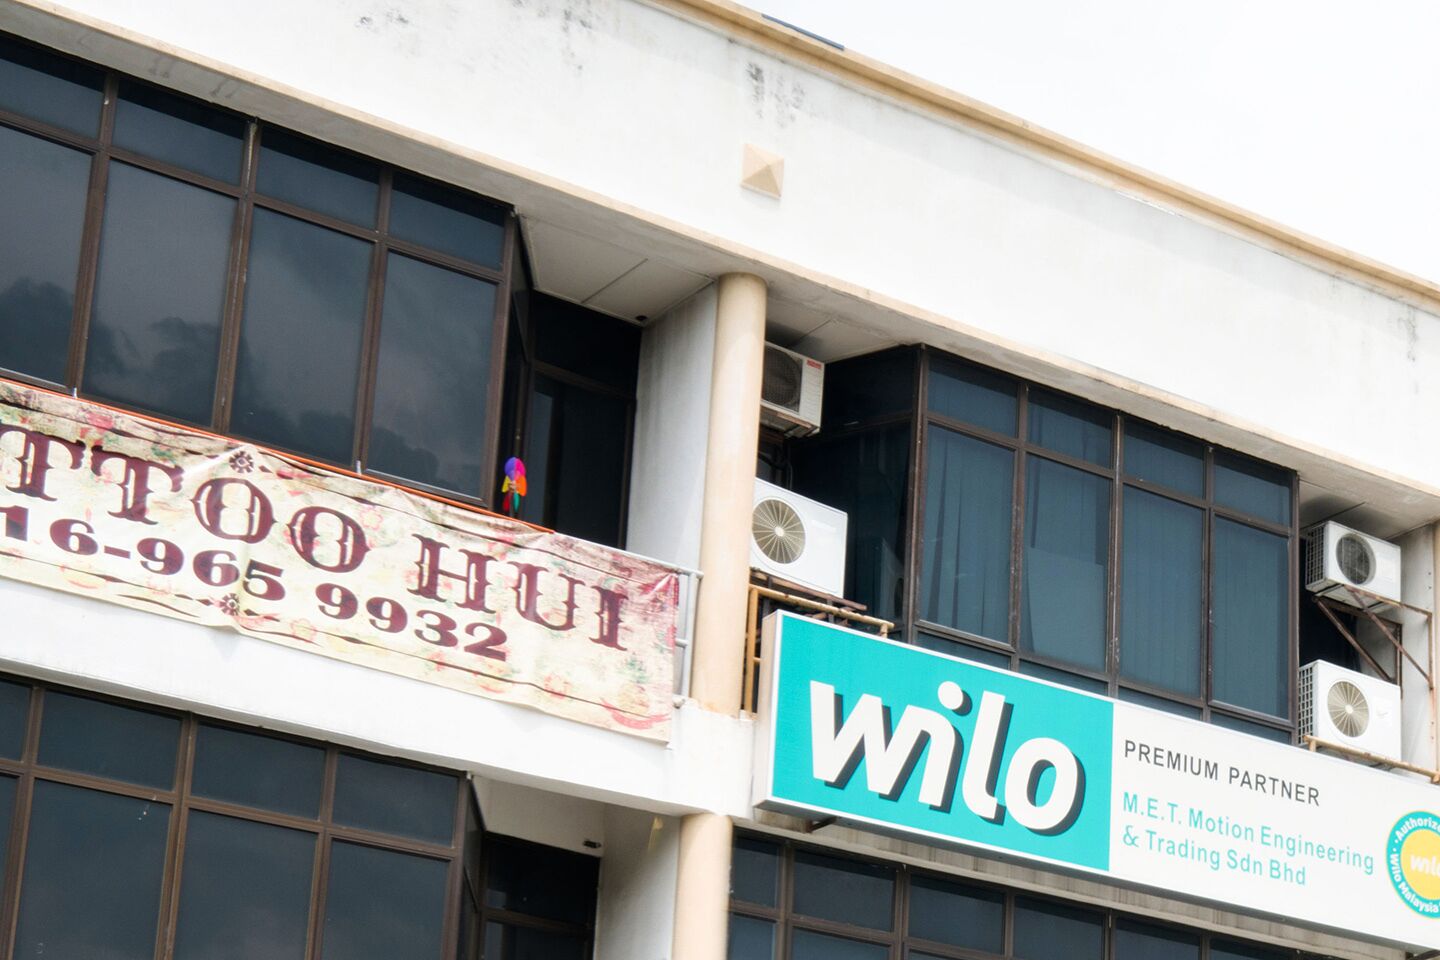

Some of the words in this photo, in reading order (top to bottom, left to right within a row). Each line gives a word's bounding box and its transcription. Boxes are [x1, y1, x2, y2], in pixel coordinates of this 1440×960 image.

[315, 583, 508, 662] 9932
[407, 533, 629, 652] HUI
[810, 680, 1087, 838] wilo
[1124, 739, 1219, 781] PREMIUM
[1229, 766, 1320, 807] PARTNER
[1123, 791, 1182, 825] M.E.T.
[1189, 807, 1254, 842] Motion
[1261, 825, 1374, 876] Engineering
[1123, 825, 1139, 848] &
[1146, 829, 1221, 871] Trading
[1227, 849, 1263, 876] Sdn
[1269, 859, 1306, 885] Bhd
[1398, 881, 1440, 913] Malaysia
